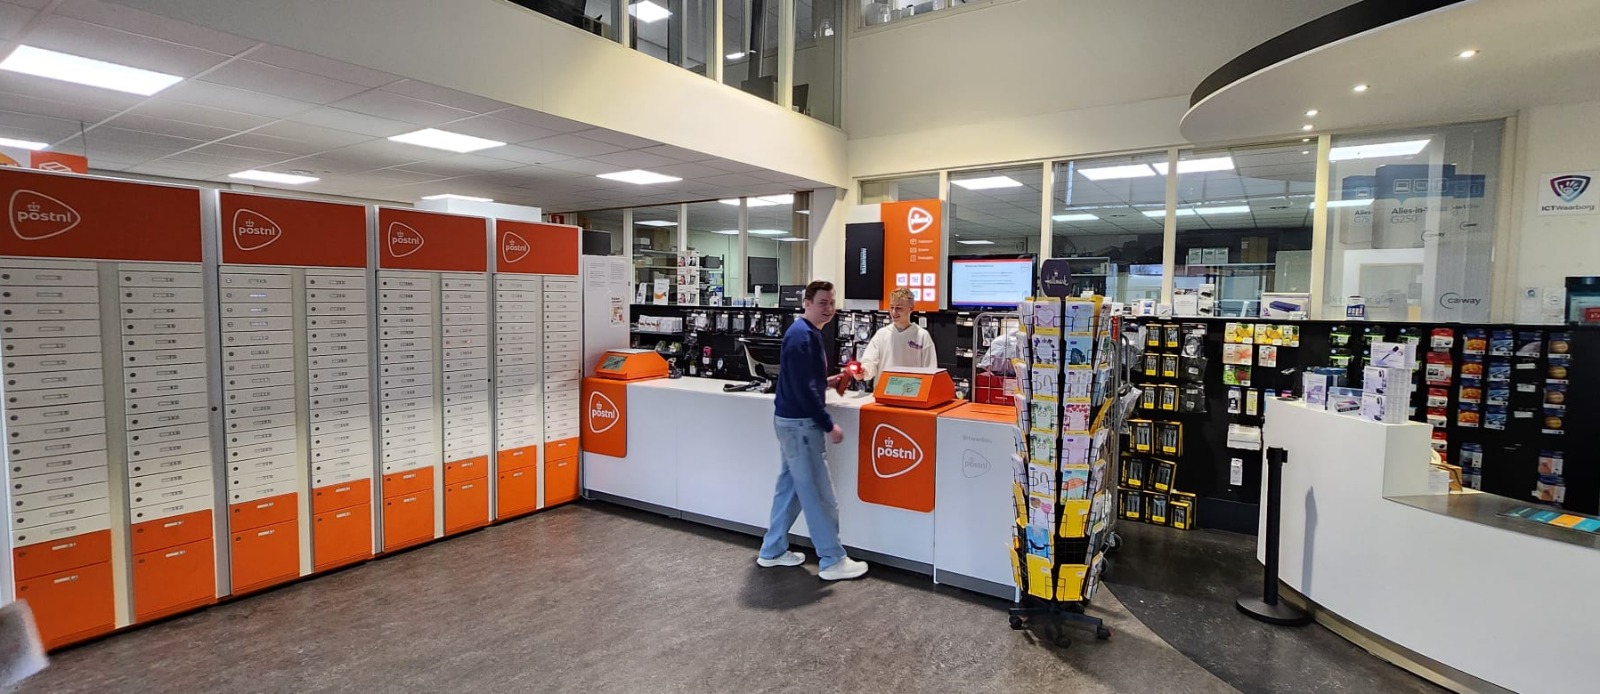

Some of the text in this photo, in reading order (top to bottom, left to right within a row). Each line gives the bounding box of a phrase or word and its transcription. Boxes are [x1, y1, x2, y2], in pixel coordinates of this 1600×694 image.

[17, 211, 72, 222] postnl
[238, 225, 275, 236] postnl
[392, 235, 419, 245] postnl
[505, 242, 527, 253] postnl
[592, 409, 615, 419] postnl
[877, 446, 916, 460] postnl
